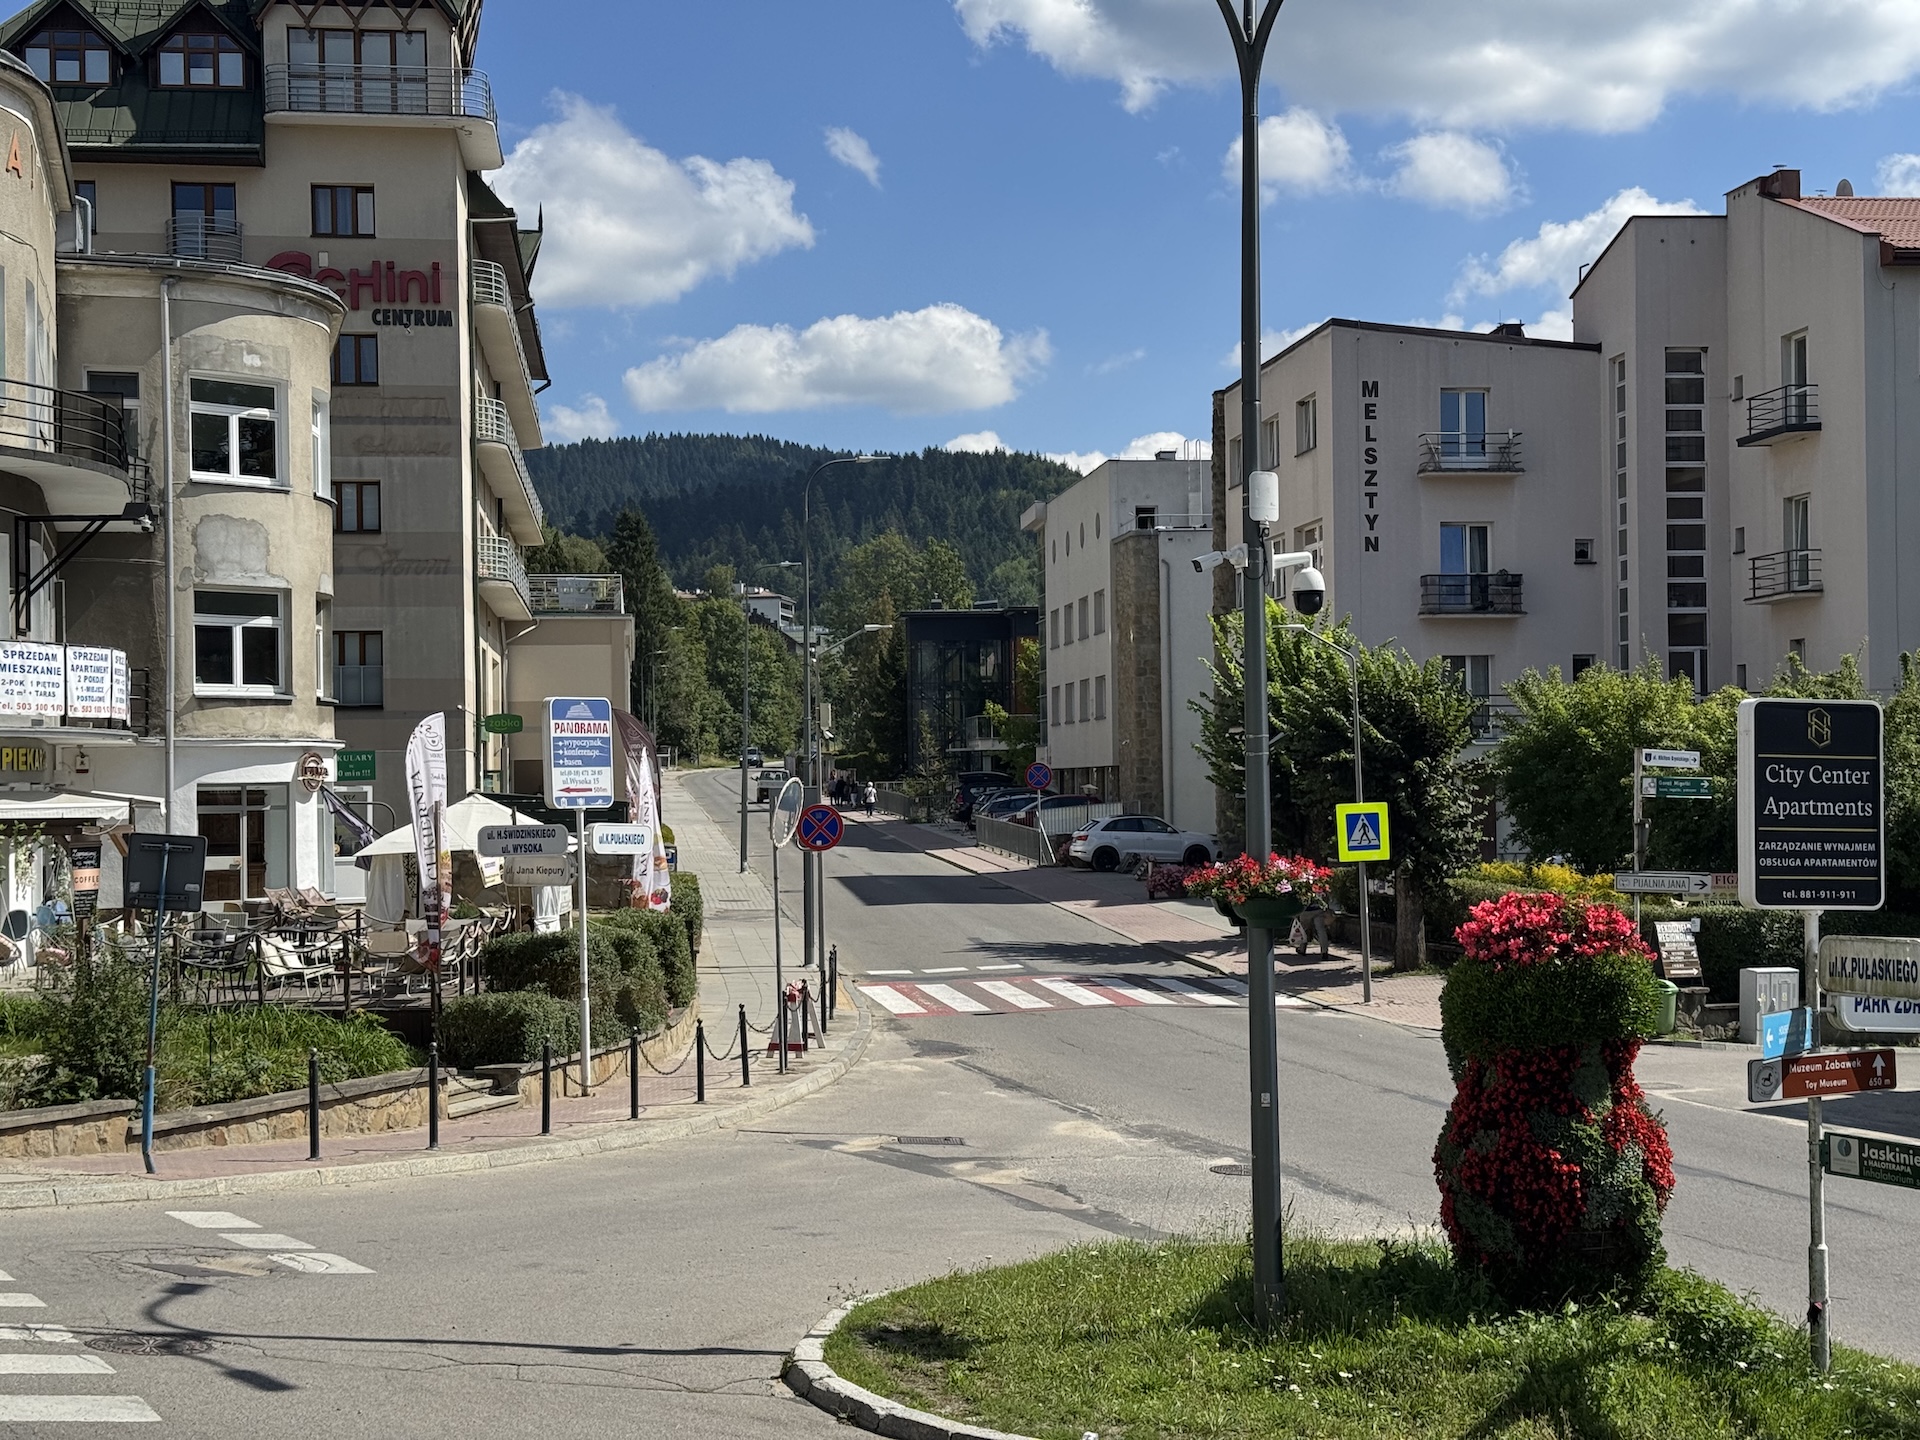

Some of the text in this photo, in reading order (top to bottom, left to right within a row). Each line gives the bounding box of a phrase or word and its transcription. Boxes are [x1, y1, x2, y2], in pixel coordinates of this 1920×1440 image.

[371, 308, 453, 327] CENTRUM
[1361, 380, 1380, 552] MELSZTYN
[3, 649, 58, 662] SPRZEDAM
[0, 663, 62, 676] MIESZKANIE
[35, 690, 56, 698] TARAS
[16, 702, 32, 711] 503
[554, 722, 608, 734] PANORAMA
[1765, 764, 1870, 788] City Center
[1763, 796, 1873, 819] Apartments
[486, 831, 496, 840] ul.
[501, 843, 543, 854] ul. WYSOKA
[1759, 842, 1876, 852] ZARZĄDZANIE WYNAJMEM
[1759, 857, 1878, 867] OBSŁUGA APARTAMENTÓW
[516, 866, 534, 875] Jana
[536, 866, 565, 877] Kiepury
[1667, 880, 1687, 889] JANA
[1782, 890, 1856, 898] tel. 881-911-911
[1854, 997, 1890, 1014] PARK
[1789, 1058, 1862, 1073] Muzeum Zabawek
[1804, 1078, 1848, 1090] Toy Museum
[1869, 1077, 1882, 1086] 650
